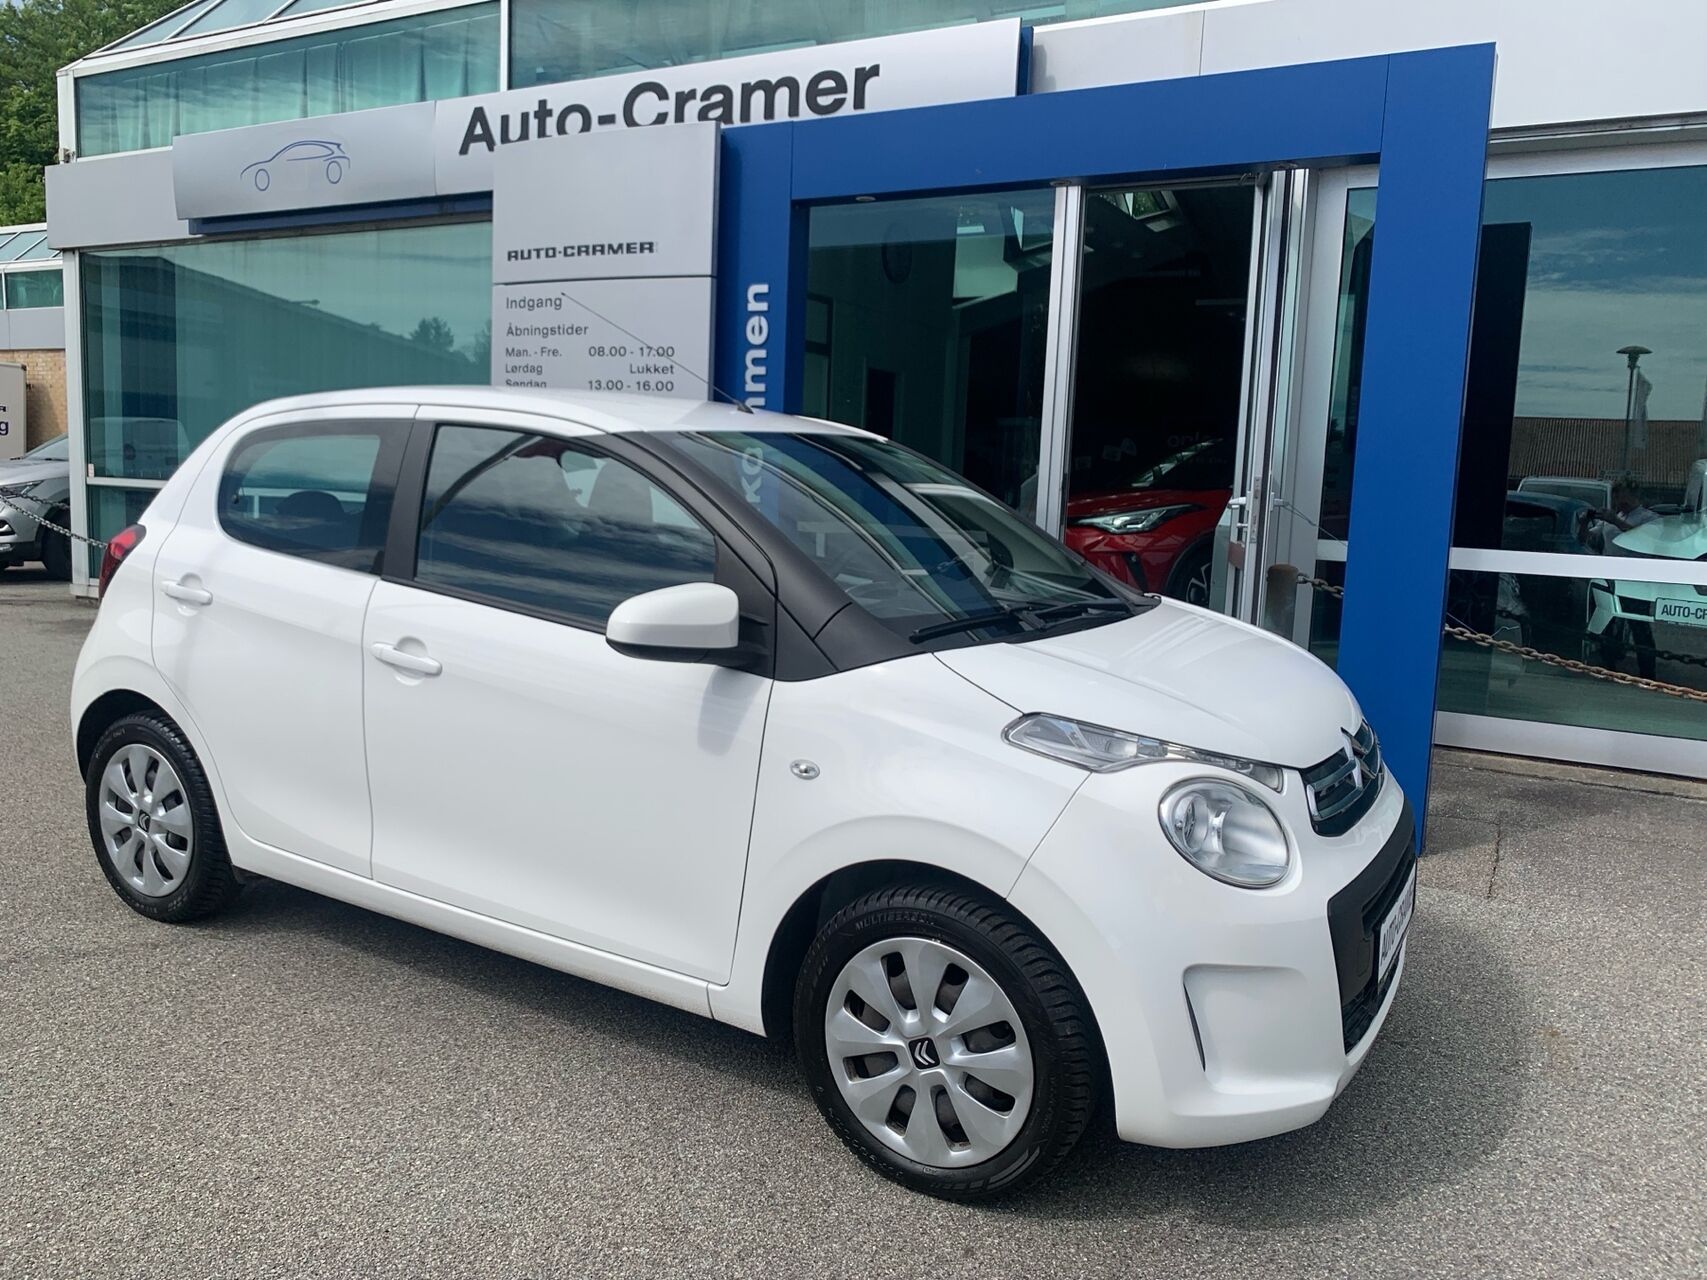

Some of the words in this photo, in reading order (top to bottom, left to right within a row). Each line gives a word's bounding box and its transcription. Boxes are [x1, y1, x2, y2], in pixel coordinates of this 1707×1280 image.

[459, 63, 880, 156] Auto-Cramer
[505, 296, 563, 311] Indgang
[505, 323, 589, 338] Åbningstider
[588, 346, 627, 357] 08.00
[640, 346, 675, 357] 17.00
[505, 363, 543, 375] Lørdag
[630, 363, 675, 375] Lukket
[588, 380, 624, 391] 13.00
[637, 380, 674, 392] 16.00
